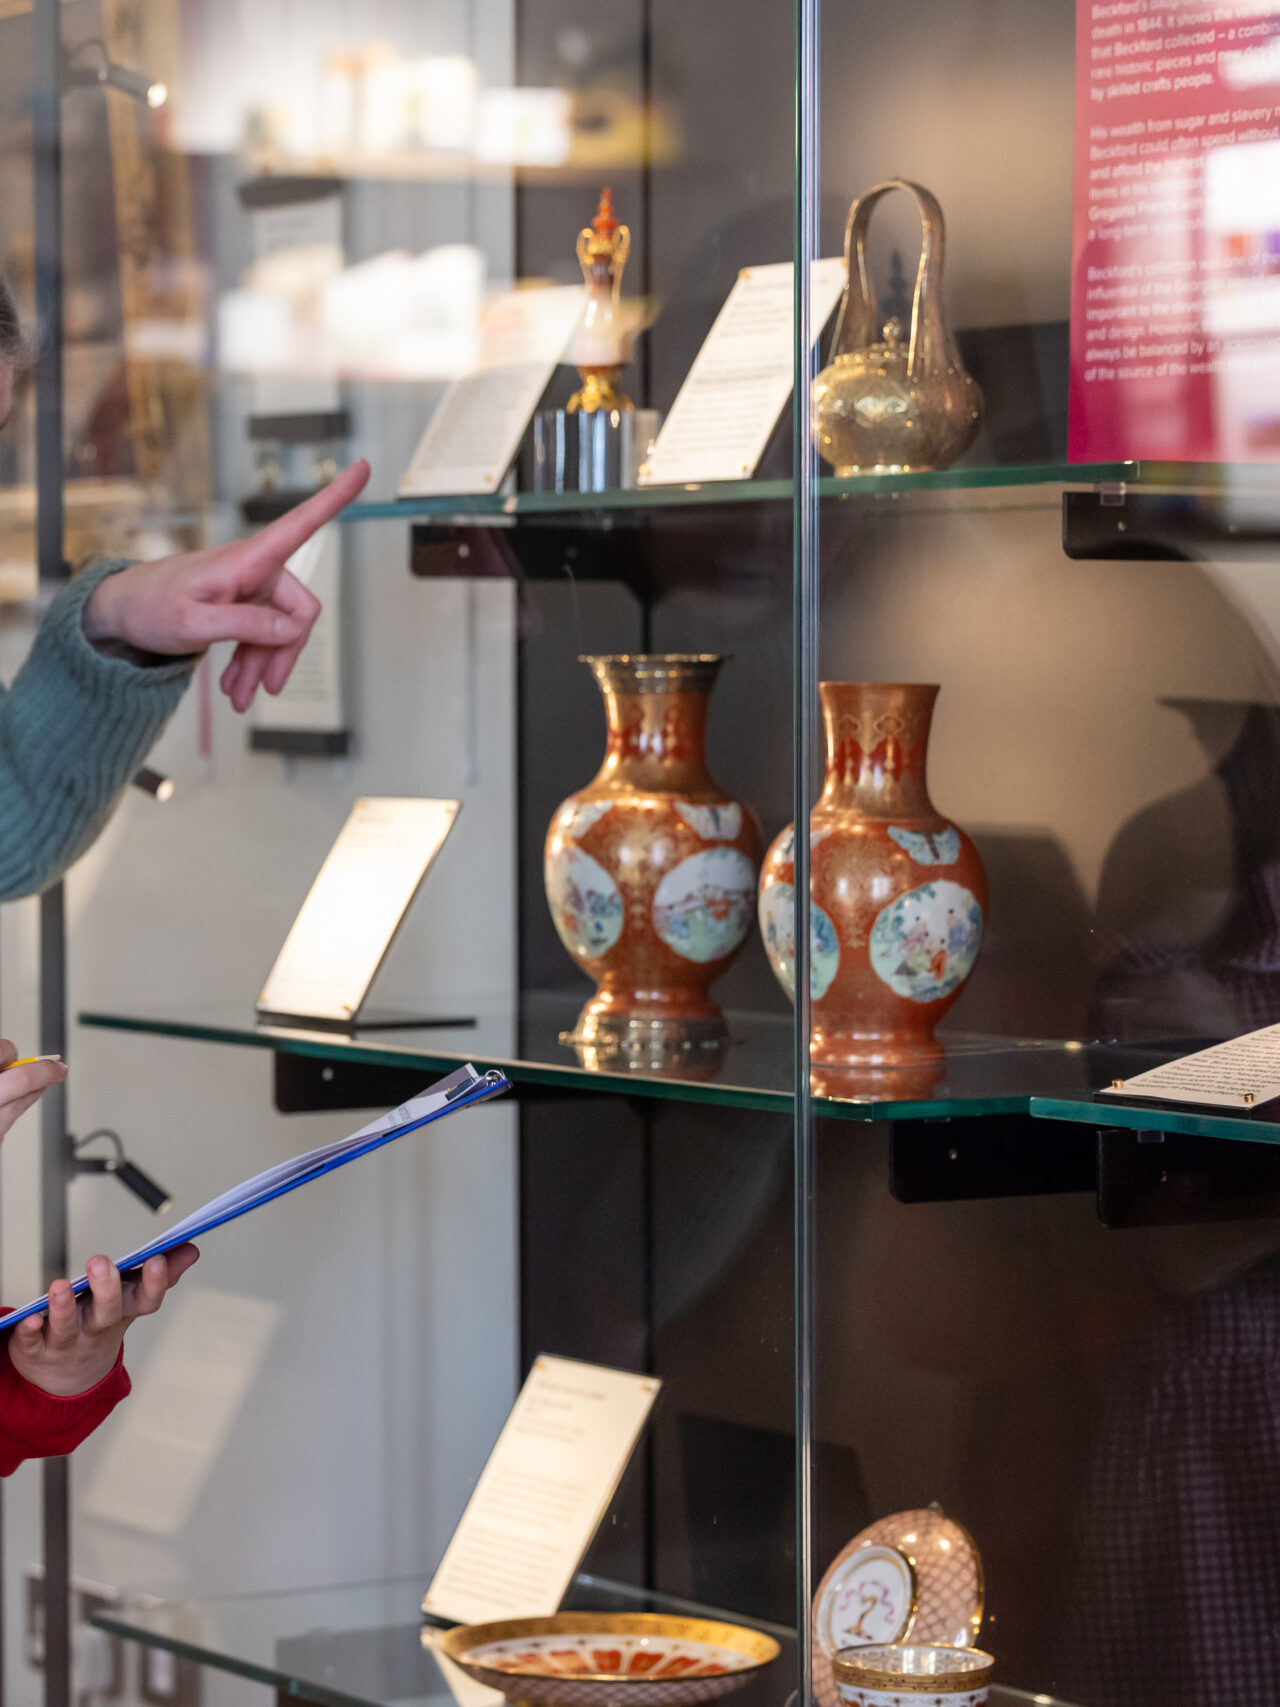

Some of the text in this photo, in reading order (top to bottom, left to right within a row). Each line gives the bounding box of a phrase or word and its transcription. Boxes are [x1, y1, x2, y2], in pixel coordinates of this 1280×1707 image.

[1091, 24, 1123, 40] death
[1124, 22, 1135, 34] in
[1176, 12, 1212, 27] shows
[1214, 7, 1233, 21] the
[1091, 46, 1112, 60] that
[1114, 38, 1163, 57] Beckford
[1164, 29, 1215, 50] collected
[1227, 29, 1235, 41] a
[1237, 20, 1280, 39] combin
[1114, 60, 1154, 77] historic
[1155, 55, 1193, 74] pieces
[1194, 50, 1216, 66] and
[1142, 76, 1172, 94] crafts
[1089, 125, 1108, 140] His
[1110, 121, 1146, 138] wealth
[1147, 118, 1173, 132] from
[1174, 115, 1207, 132] sugar
[1208, 109, 1230, 126] and
[1231, 105, 1273, 123] slavery
[1089, 143, 1138, 161] Beckford
[1139, 138, 1170, 155] could
[1170, 135, 1200, 152] often
[1201, 131, 1236, 148] spend
[1089, 166, 1111, 181] and
[1086, 326, 1107, 342] and
[1085, 348, 1121, 363] always
[1122, 344, 1137, 359] be
[1139, 340, 1188, 358] balanced
[1189, 339, 1203, 357] by
[1084, 367, 1097, 382] of
[1097, 365, 1116, 381] the
[1117, 363, 1154, 379] source
[1155, 361, 1169, 377] of
[1169, 360, 1188, 376] the
